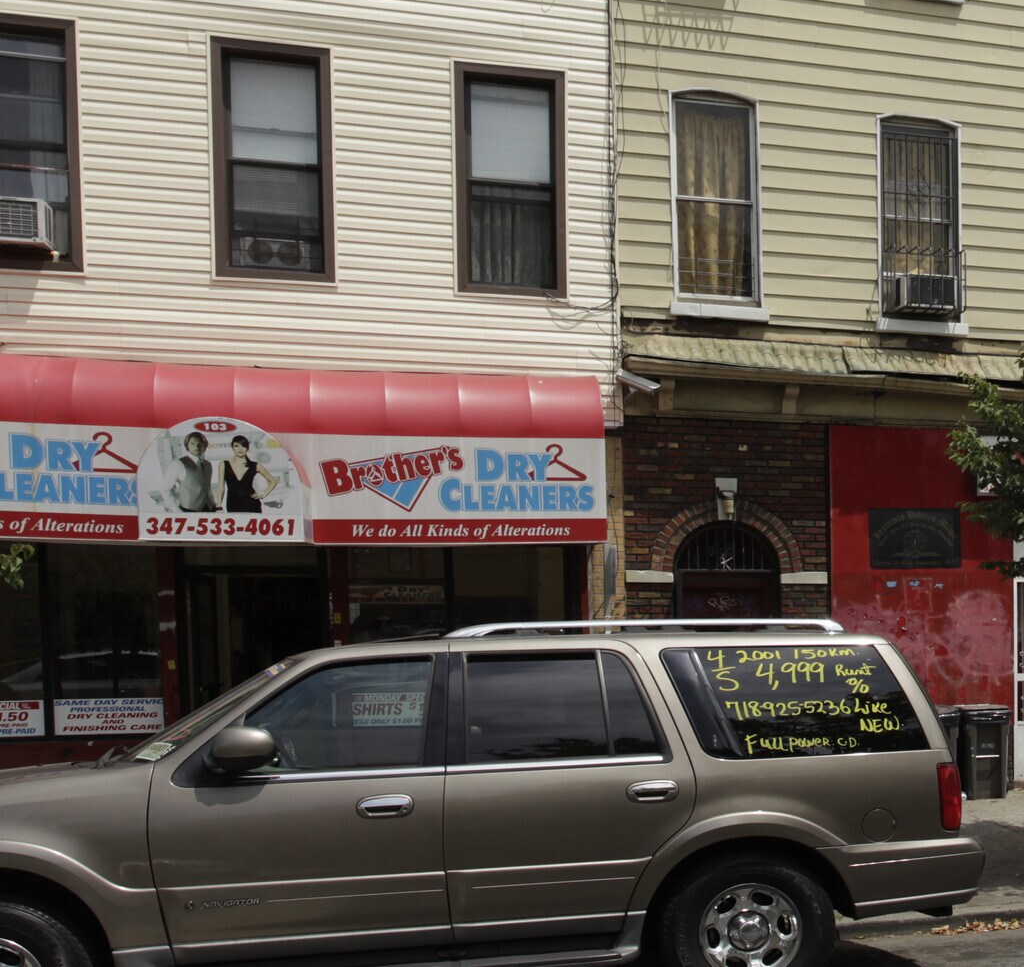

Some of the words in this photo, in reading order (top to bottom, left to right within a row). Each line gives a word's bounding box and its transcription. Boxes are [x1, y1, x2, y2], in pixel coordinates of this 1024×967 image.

[203, 422, 228, 432] 103
[9, 432, 99, 472] DRY
[320, 445, 464, 496] Brother's
[475, 448, 551, 482] DRY
[0, 471, 138, 506] LEANER
[439, 478, 596, 512] CLEANERS
[9, 516, 29, 532] of
[31, 517, 124, 534] Alterations
[146, 518, 295, 535] 347-533-4061
[352, 524, 375, 538] We
[378, 524, 397, 537] do
[400, 524, 423, 537] All
[427, 524, 469, 537] Kinds
[472, 524, 491, 540] of
[493, 524, 571, 537] Alterations
[735, 650, 781, 664] 2001
[756, 661, 825, 690] 4,999
[55, 699, 93, 707] SAME
[363, 694, 401, 702] MONDAY
[70, 705, 146, 713] PROFESSIONAL
[96, 711, 159, 719] CLEANING
[353, 702, 403, 716] SHIRTS
[725, 700, 851, 721] 718-925-5236
[62, 724, 127, 732] FINISHING
[129, 723, 163, 731] CARE
[200, 897, 261, 909] NAVIGATOR
